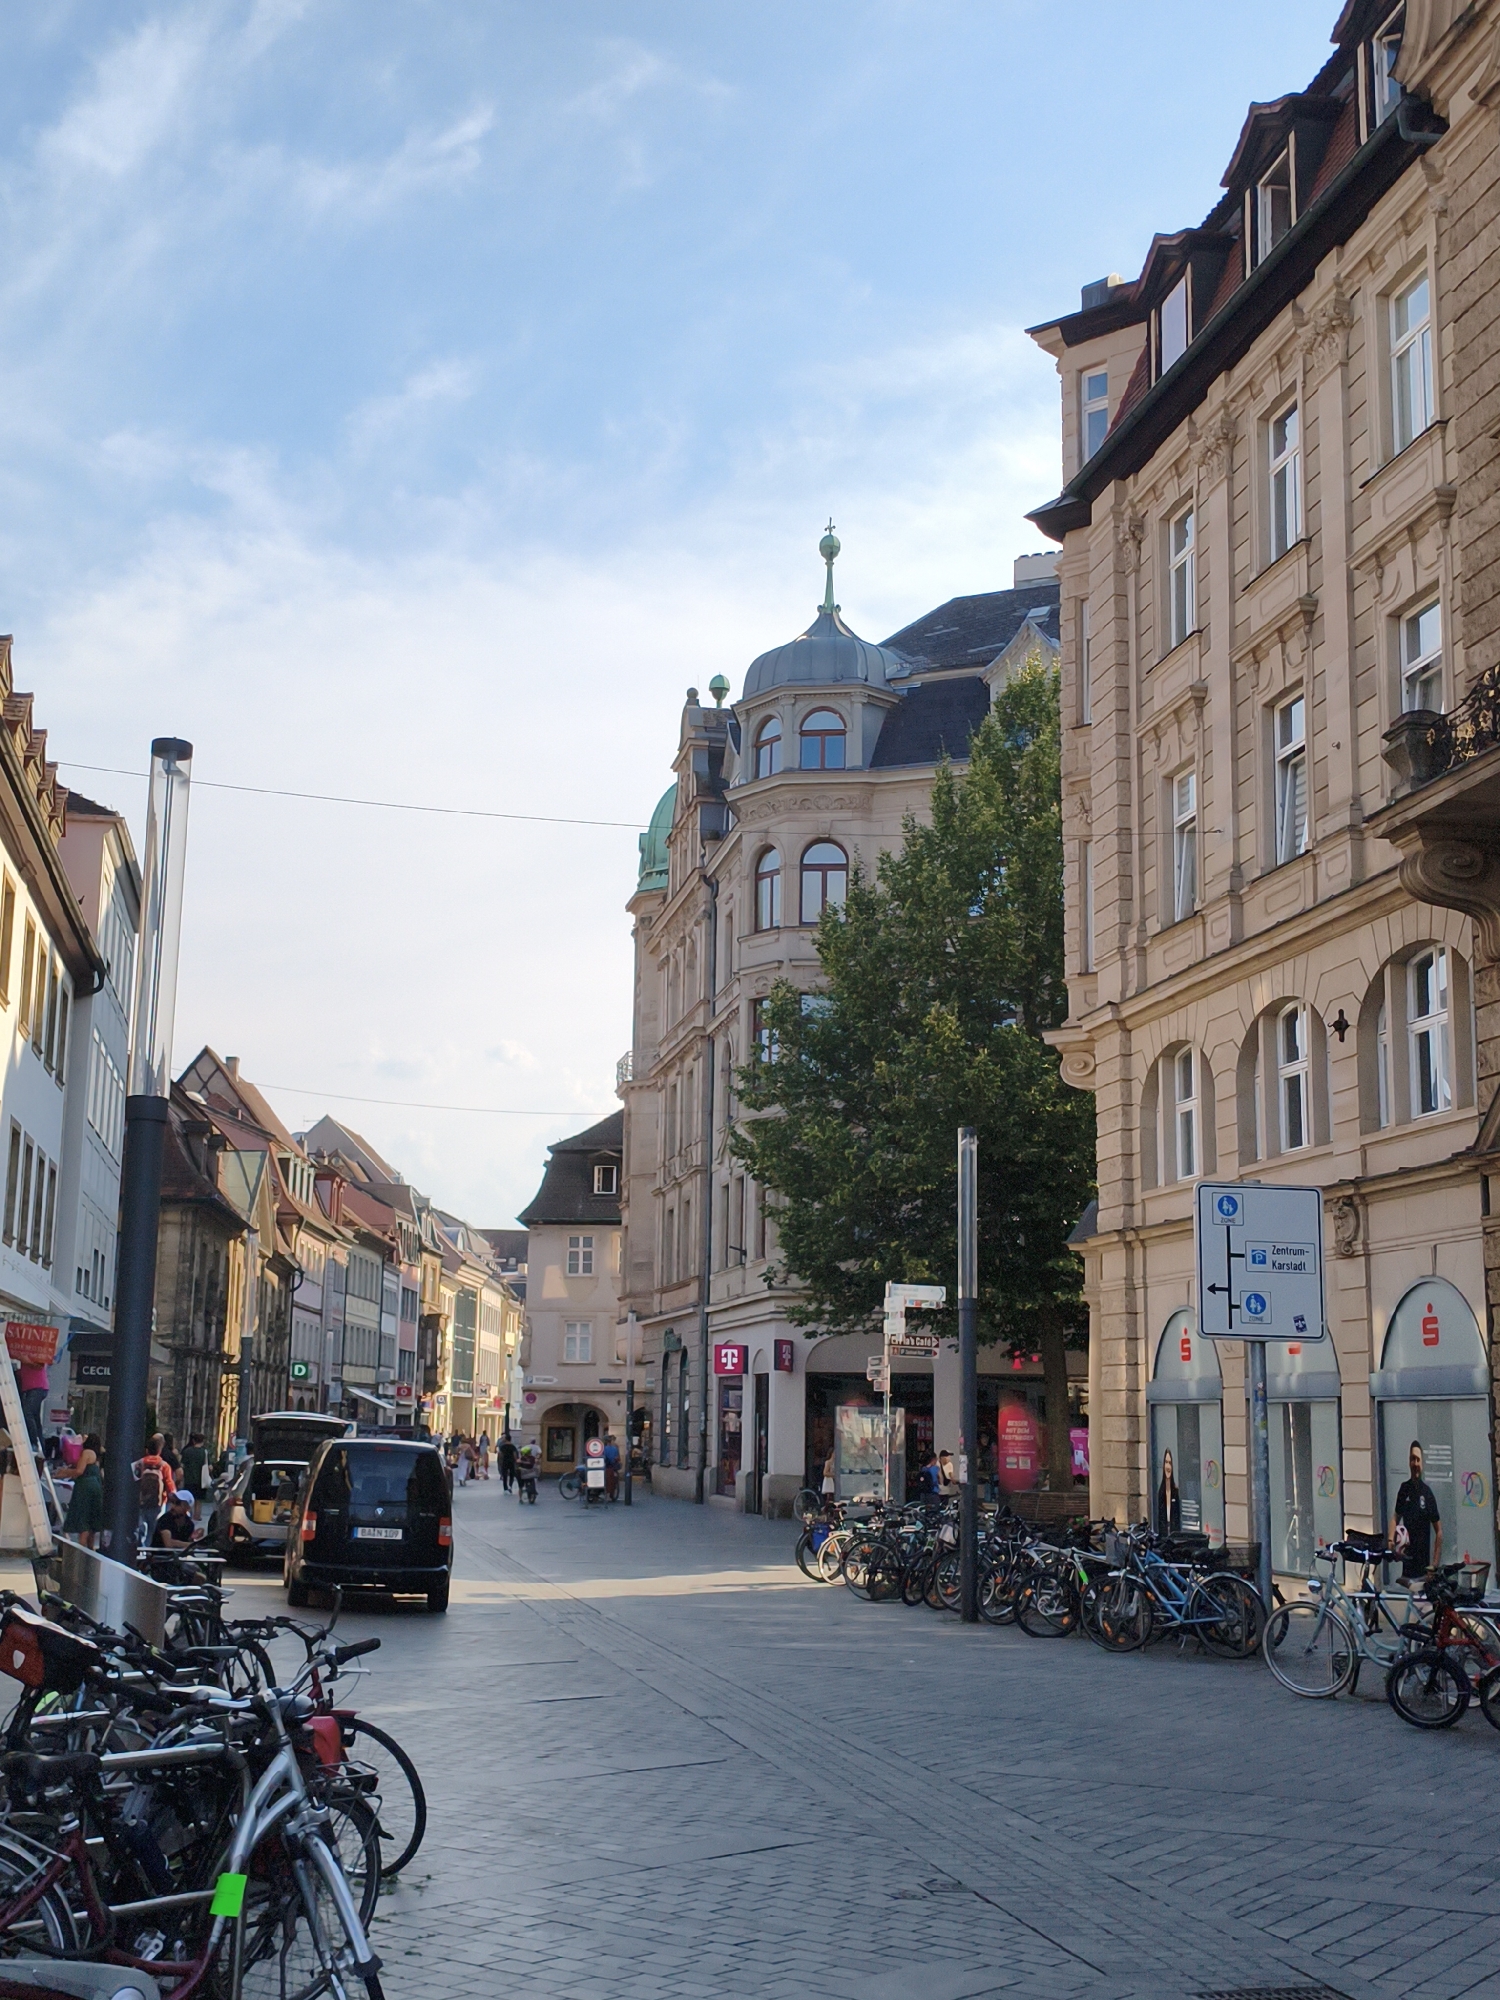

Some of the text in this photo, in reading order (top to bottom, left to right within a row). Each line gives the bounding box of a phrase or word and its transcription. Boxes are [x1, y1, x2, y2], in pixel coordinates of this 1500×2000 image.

[1271, 1245, 1309, 1256] Zentrum-
[1271, 1260, 1306, 1271] Karstadt
[721, 1348, 738, 1370] T
[782, 1344, 791, 1366] T
[82, 1366, 111, 1376] CECIL
[294, 1364, 306, 1376] D
